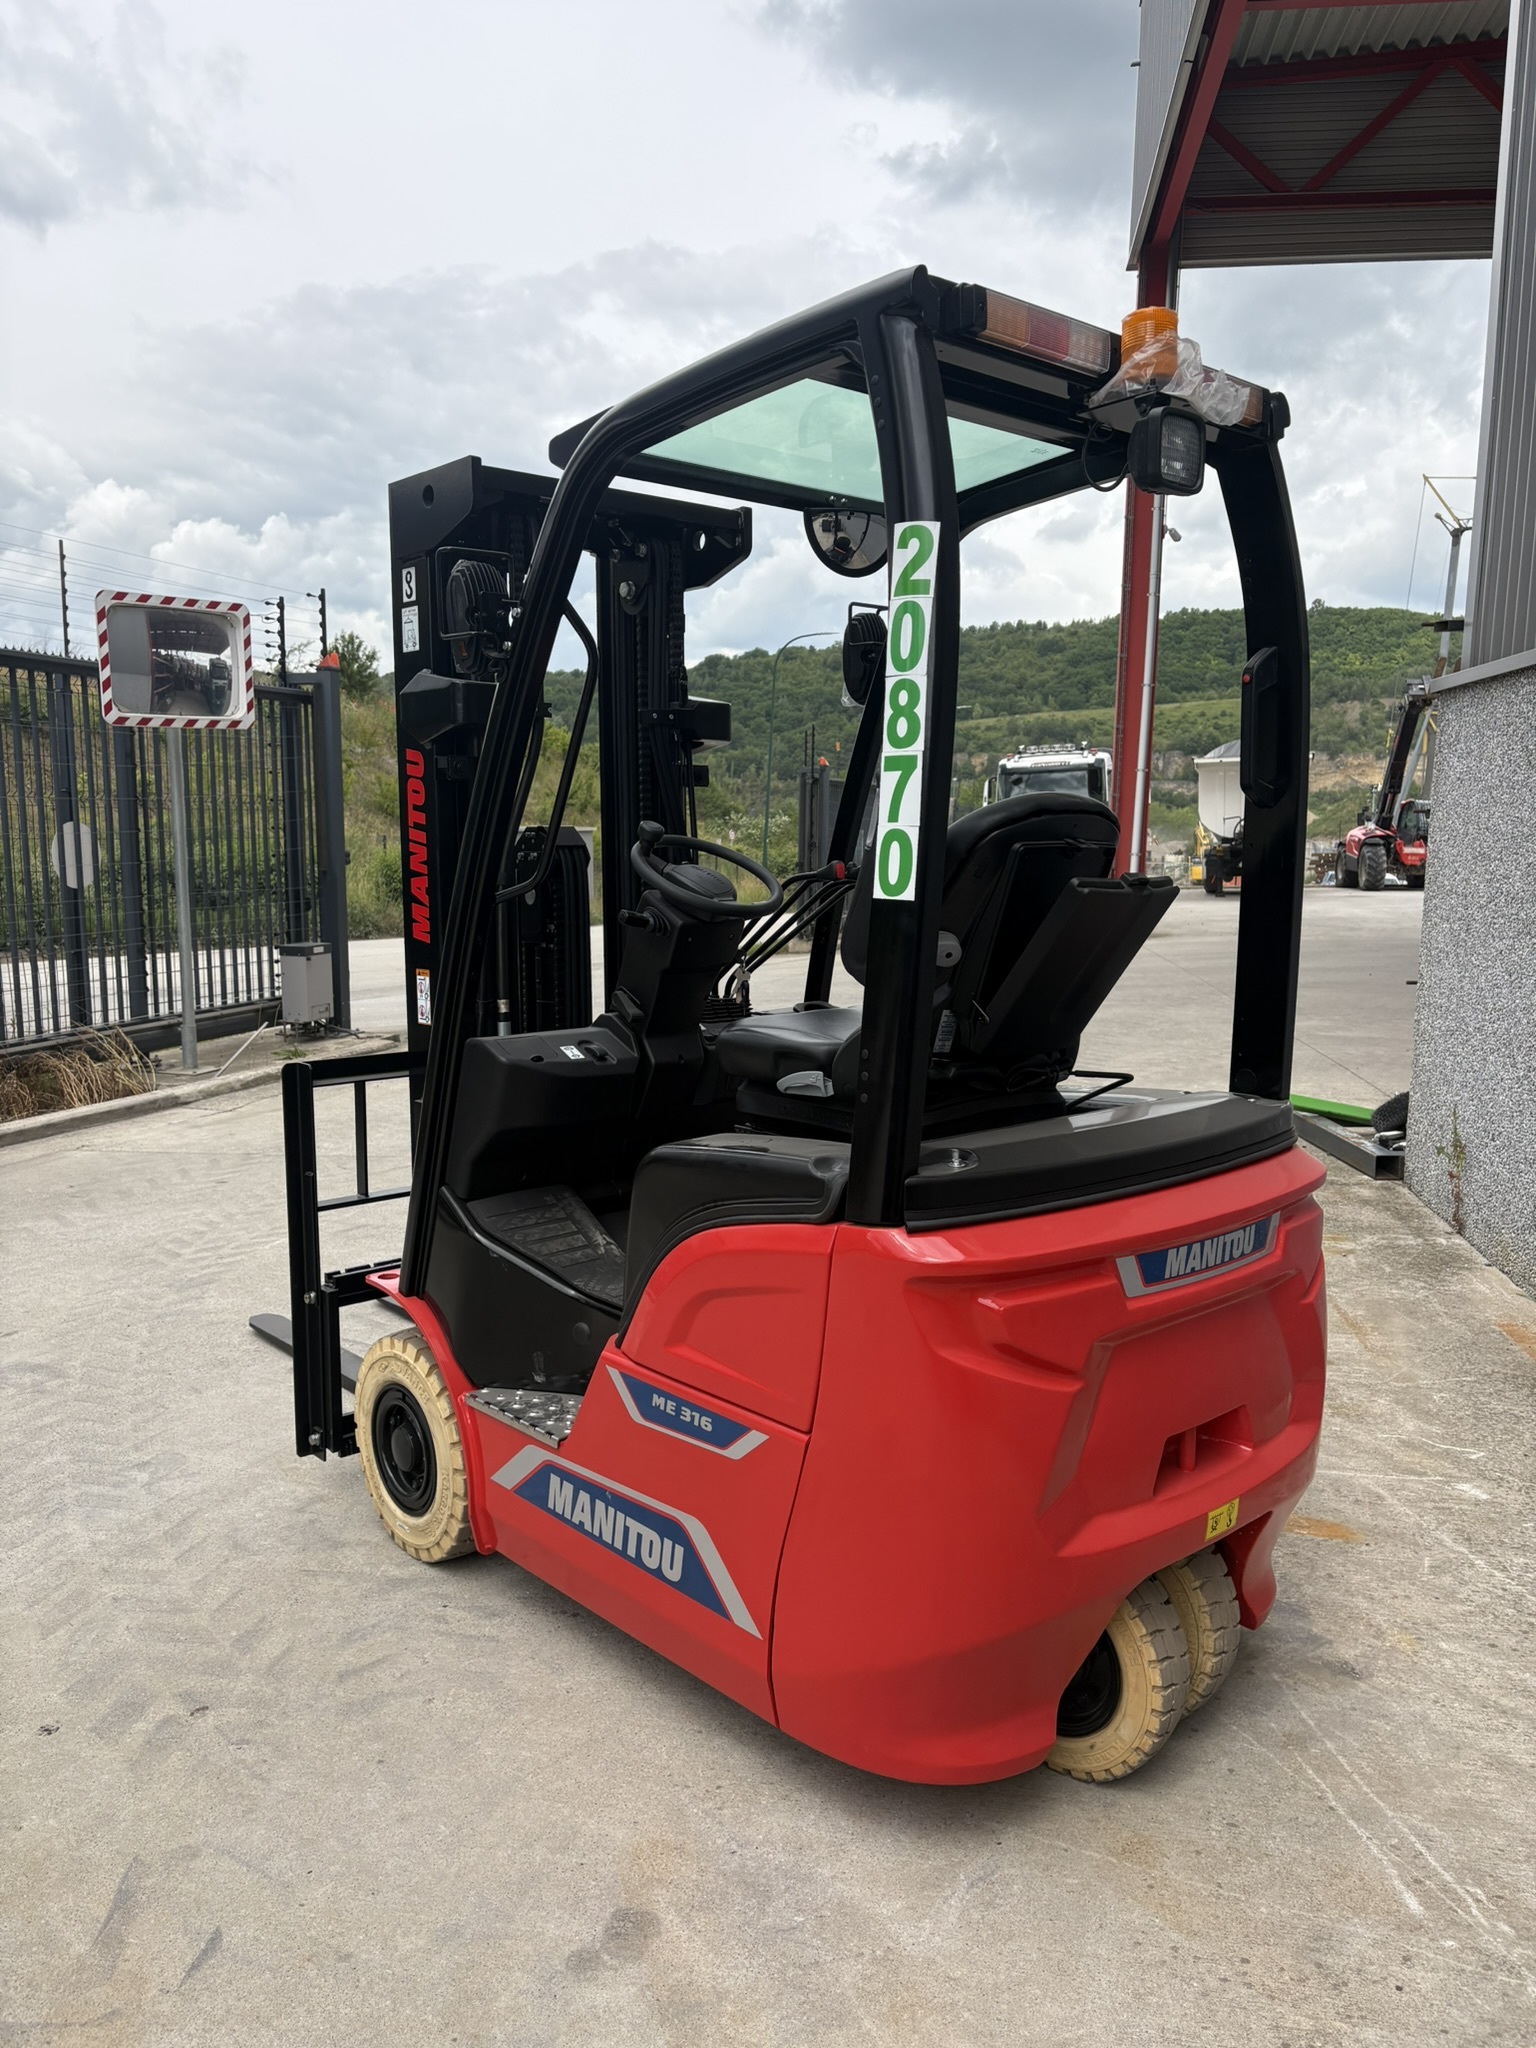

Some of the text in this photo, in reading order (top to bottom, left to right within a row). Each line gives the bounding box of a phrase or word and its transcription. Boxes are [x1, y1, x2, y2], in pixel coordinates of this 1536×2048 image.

[878, 524, 934, 898] 20870
[406, 749, 430, 943] MANITOU
[1164, 1224, 1256, 1279] MANITOU
[388, 1361, 430, 1405] ADVANCE
[652, 1393, 713, 1432] ME 316
[547, 1473, 684, 1582] MANITOU
